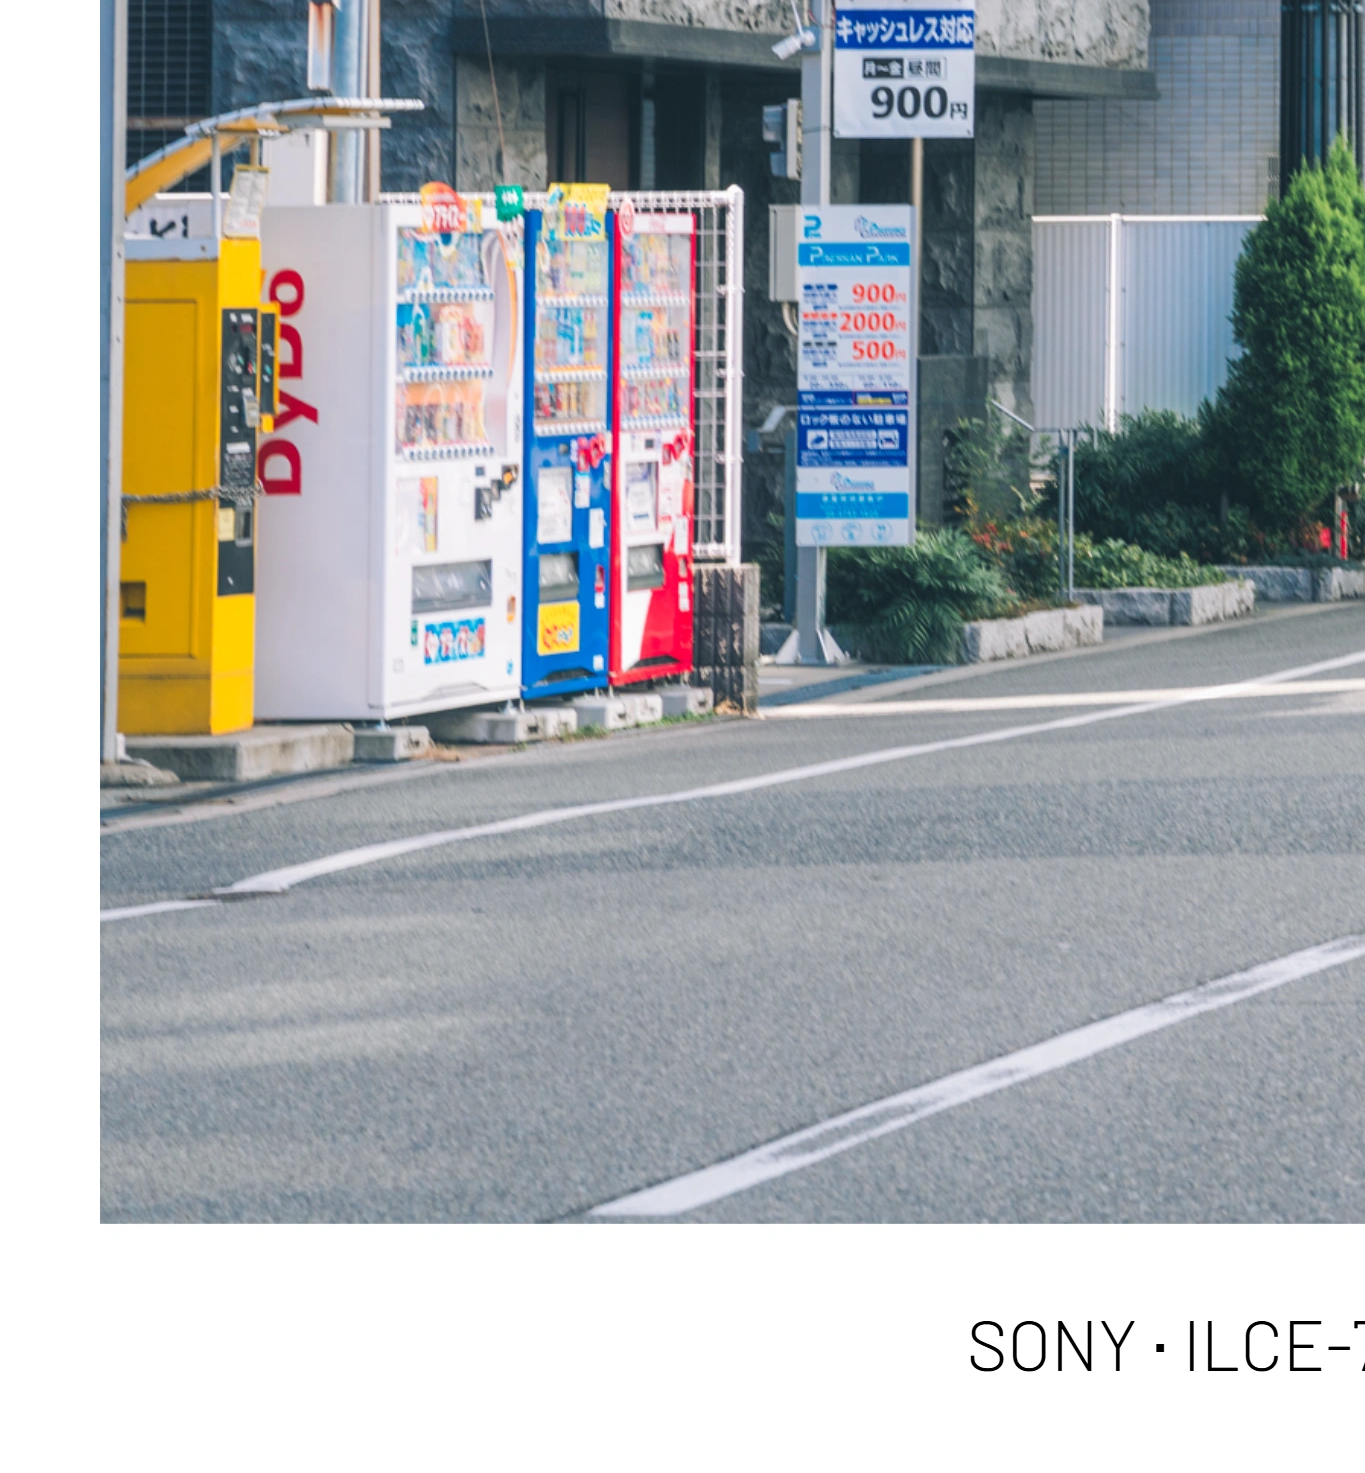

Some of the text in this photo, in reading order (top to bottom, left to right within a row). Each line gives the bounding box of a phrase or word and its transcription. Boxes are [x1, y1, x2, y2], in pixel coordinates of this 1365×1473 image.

[836, 16, 974, 45] キャッシュレス対応
[907, 58, 942, 77] 昼間
